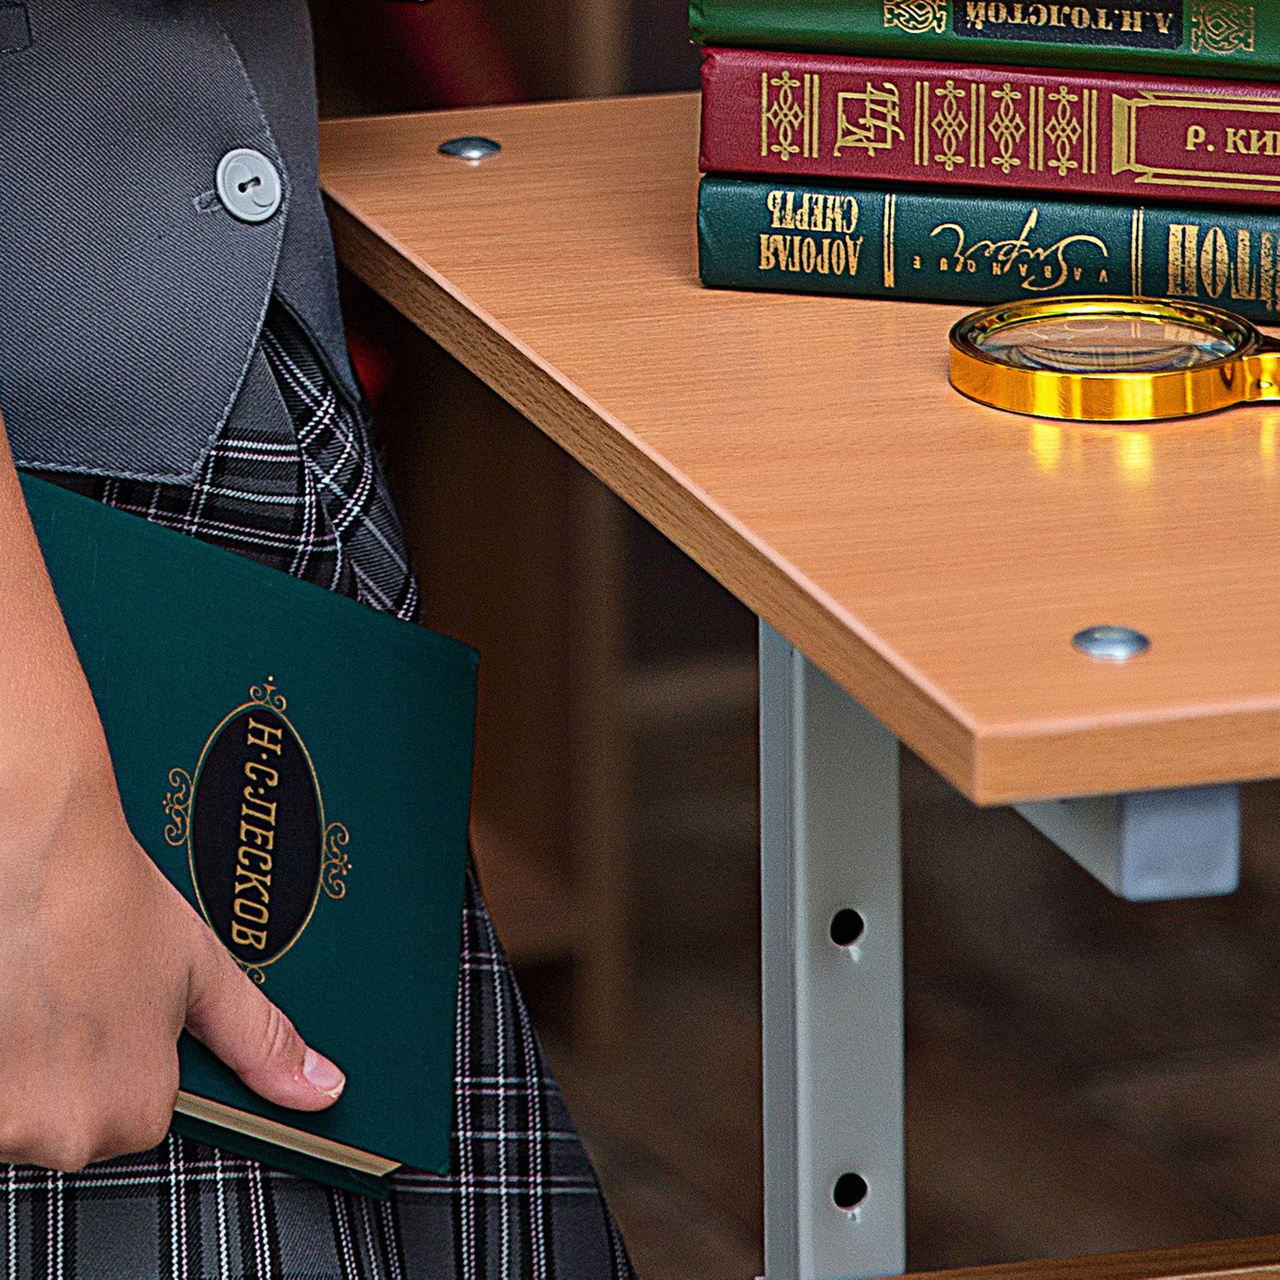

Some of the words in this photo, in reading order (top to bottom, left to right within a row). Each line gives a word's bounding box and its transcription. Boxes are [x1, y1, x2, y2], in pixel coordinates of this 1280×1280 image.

[1185, 125, 1215, 152] Р.
[765, 189, 859, 234] СМЕРТЬ
[758, 234, 863, 276] ДОРОГАЯ
